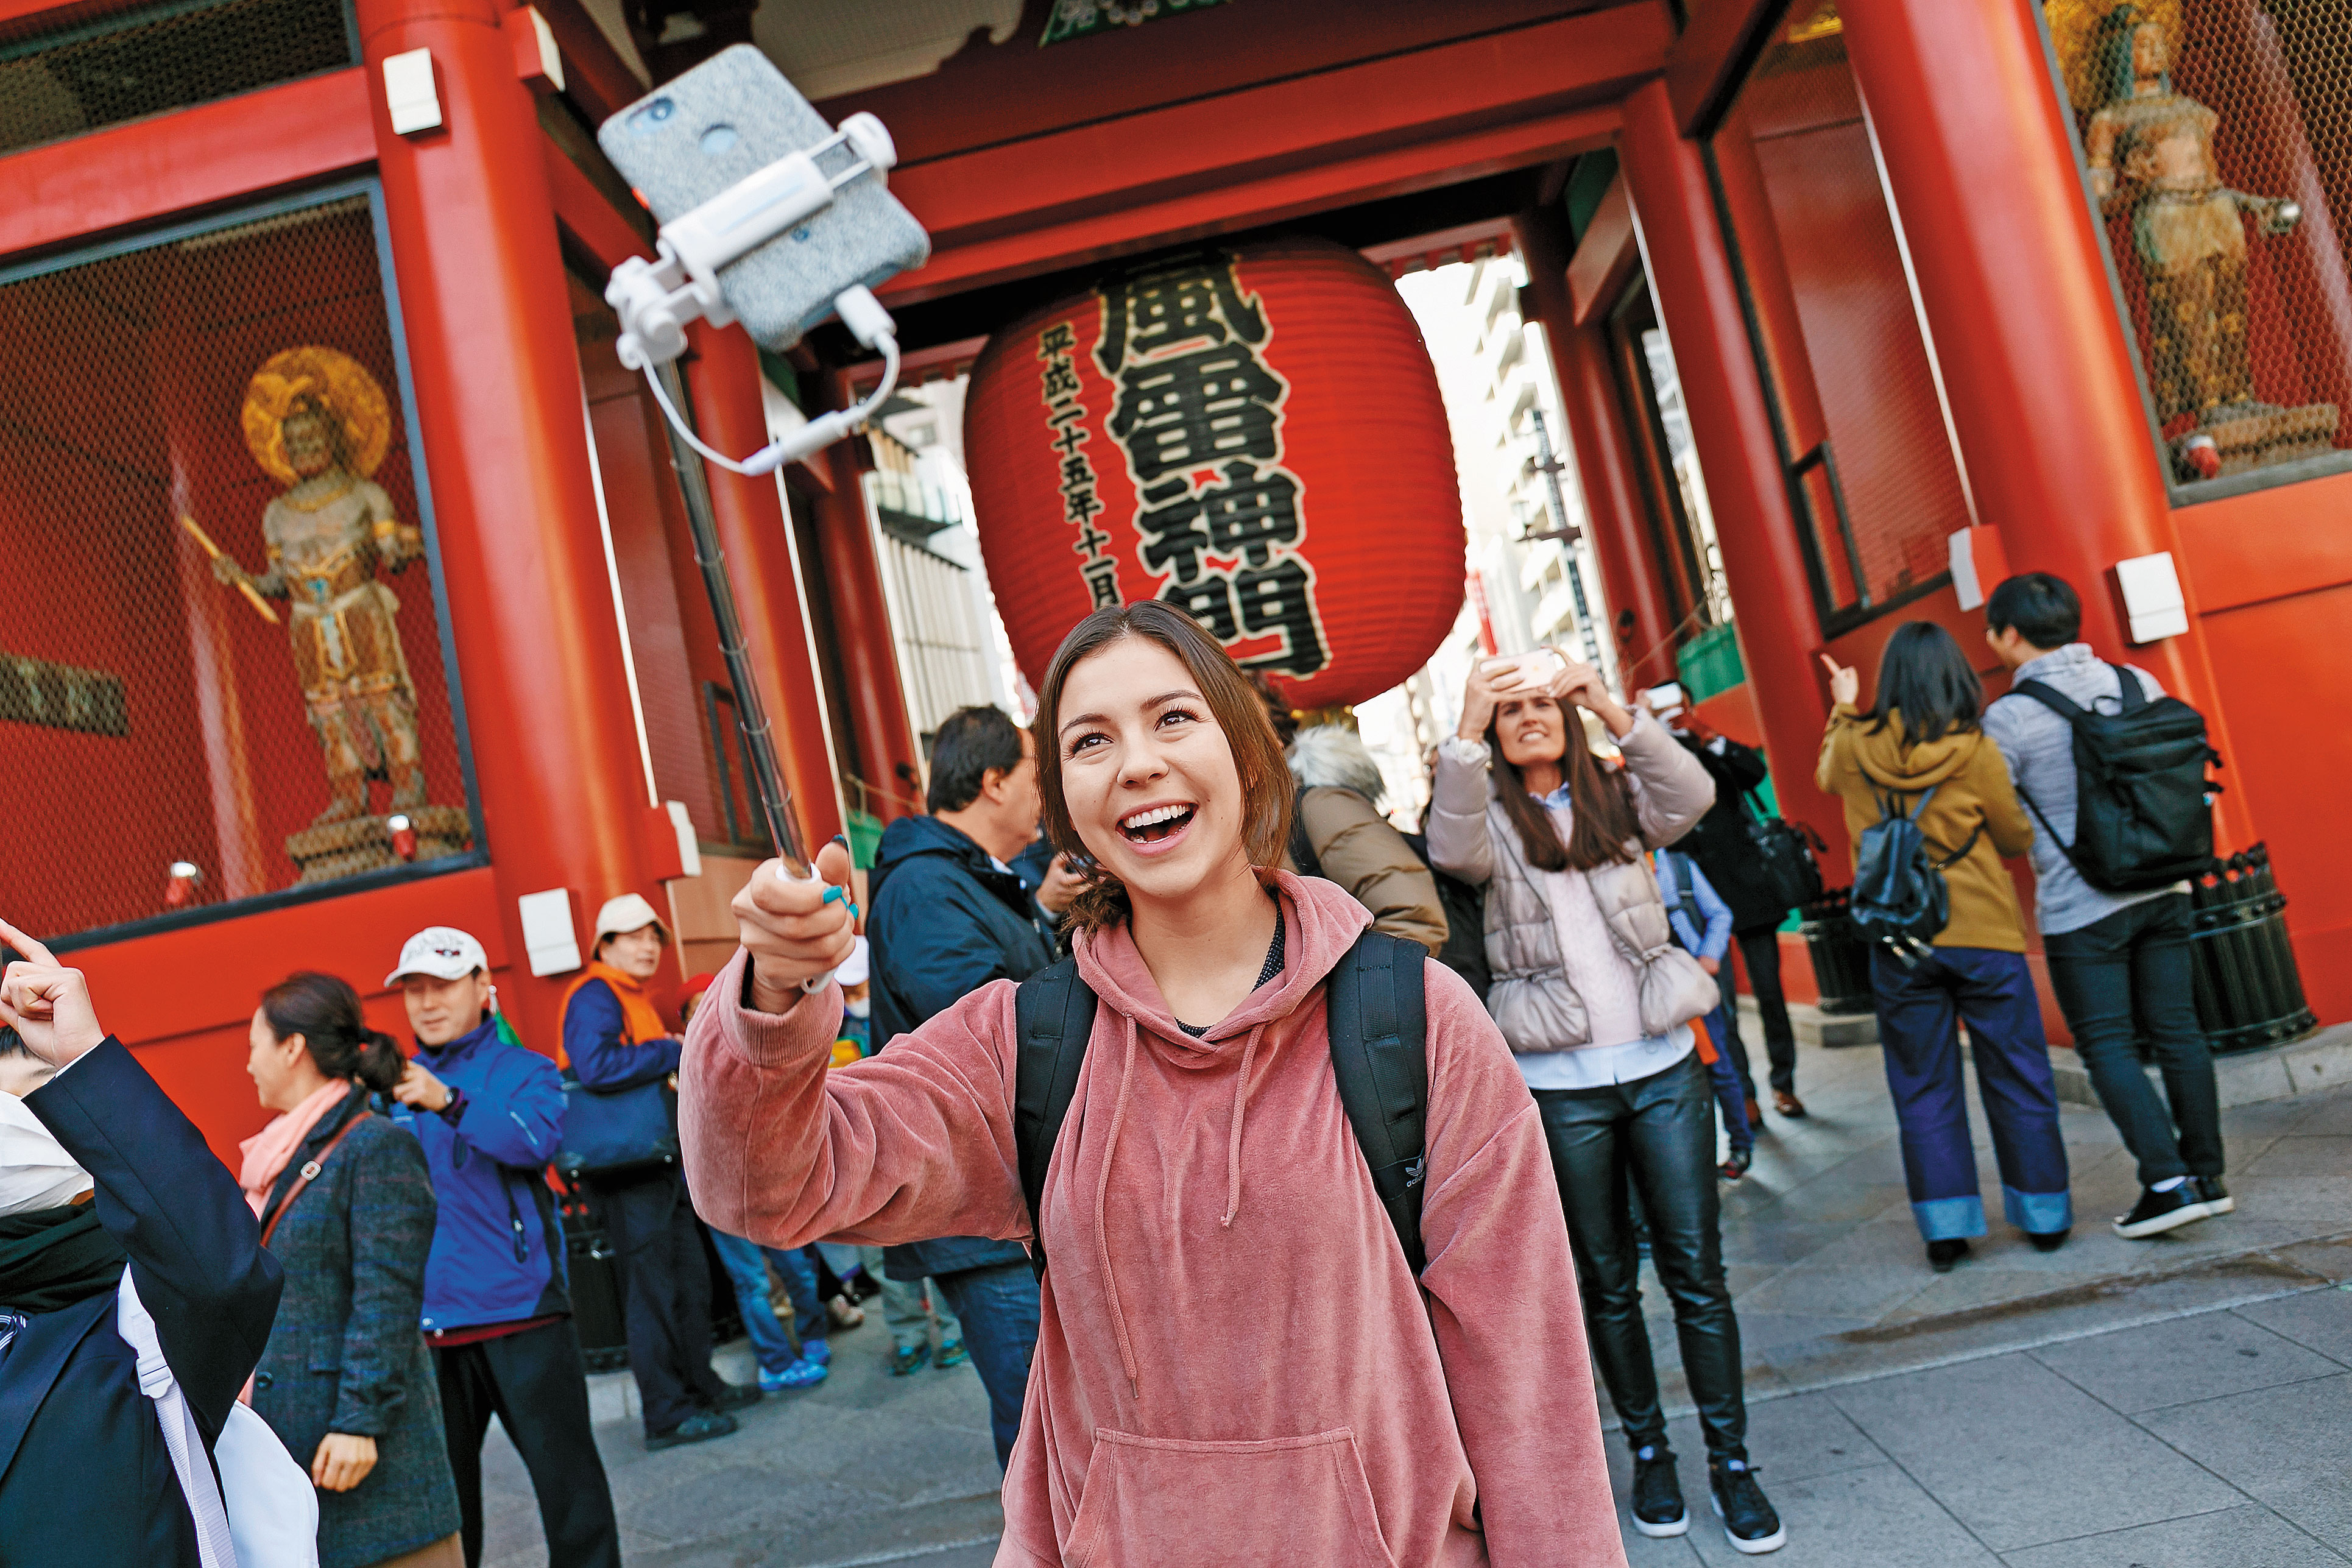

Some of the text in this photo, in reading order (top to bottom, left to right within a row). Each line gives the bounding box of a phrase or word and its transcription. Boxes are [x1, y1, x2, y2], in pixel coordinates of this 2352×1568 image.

[1039, 322, 1121, 608] 平成二十五年十一月
[1093, 249, 1330, 677] 風雷神門
[1407, 1171, 1425, 1187] adida
